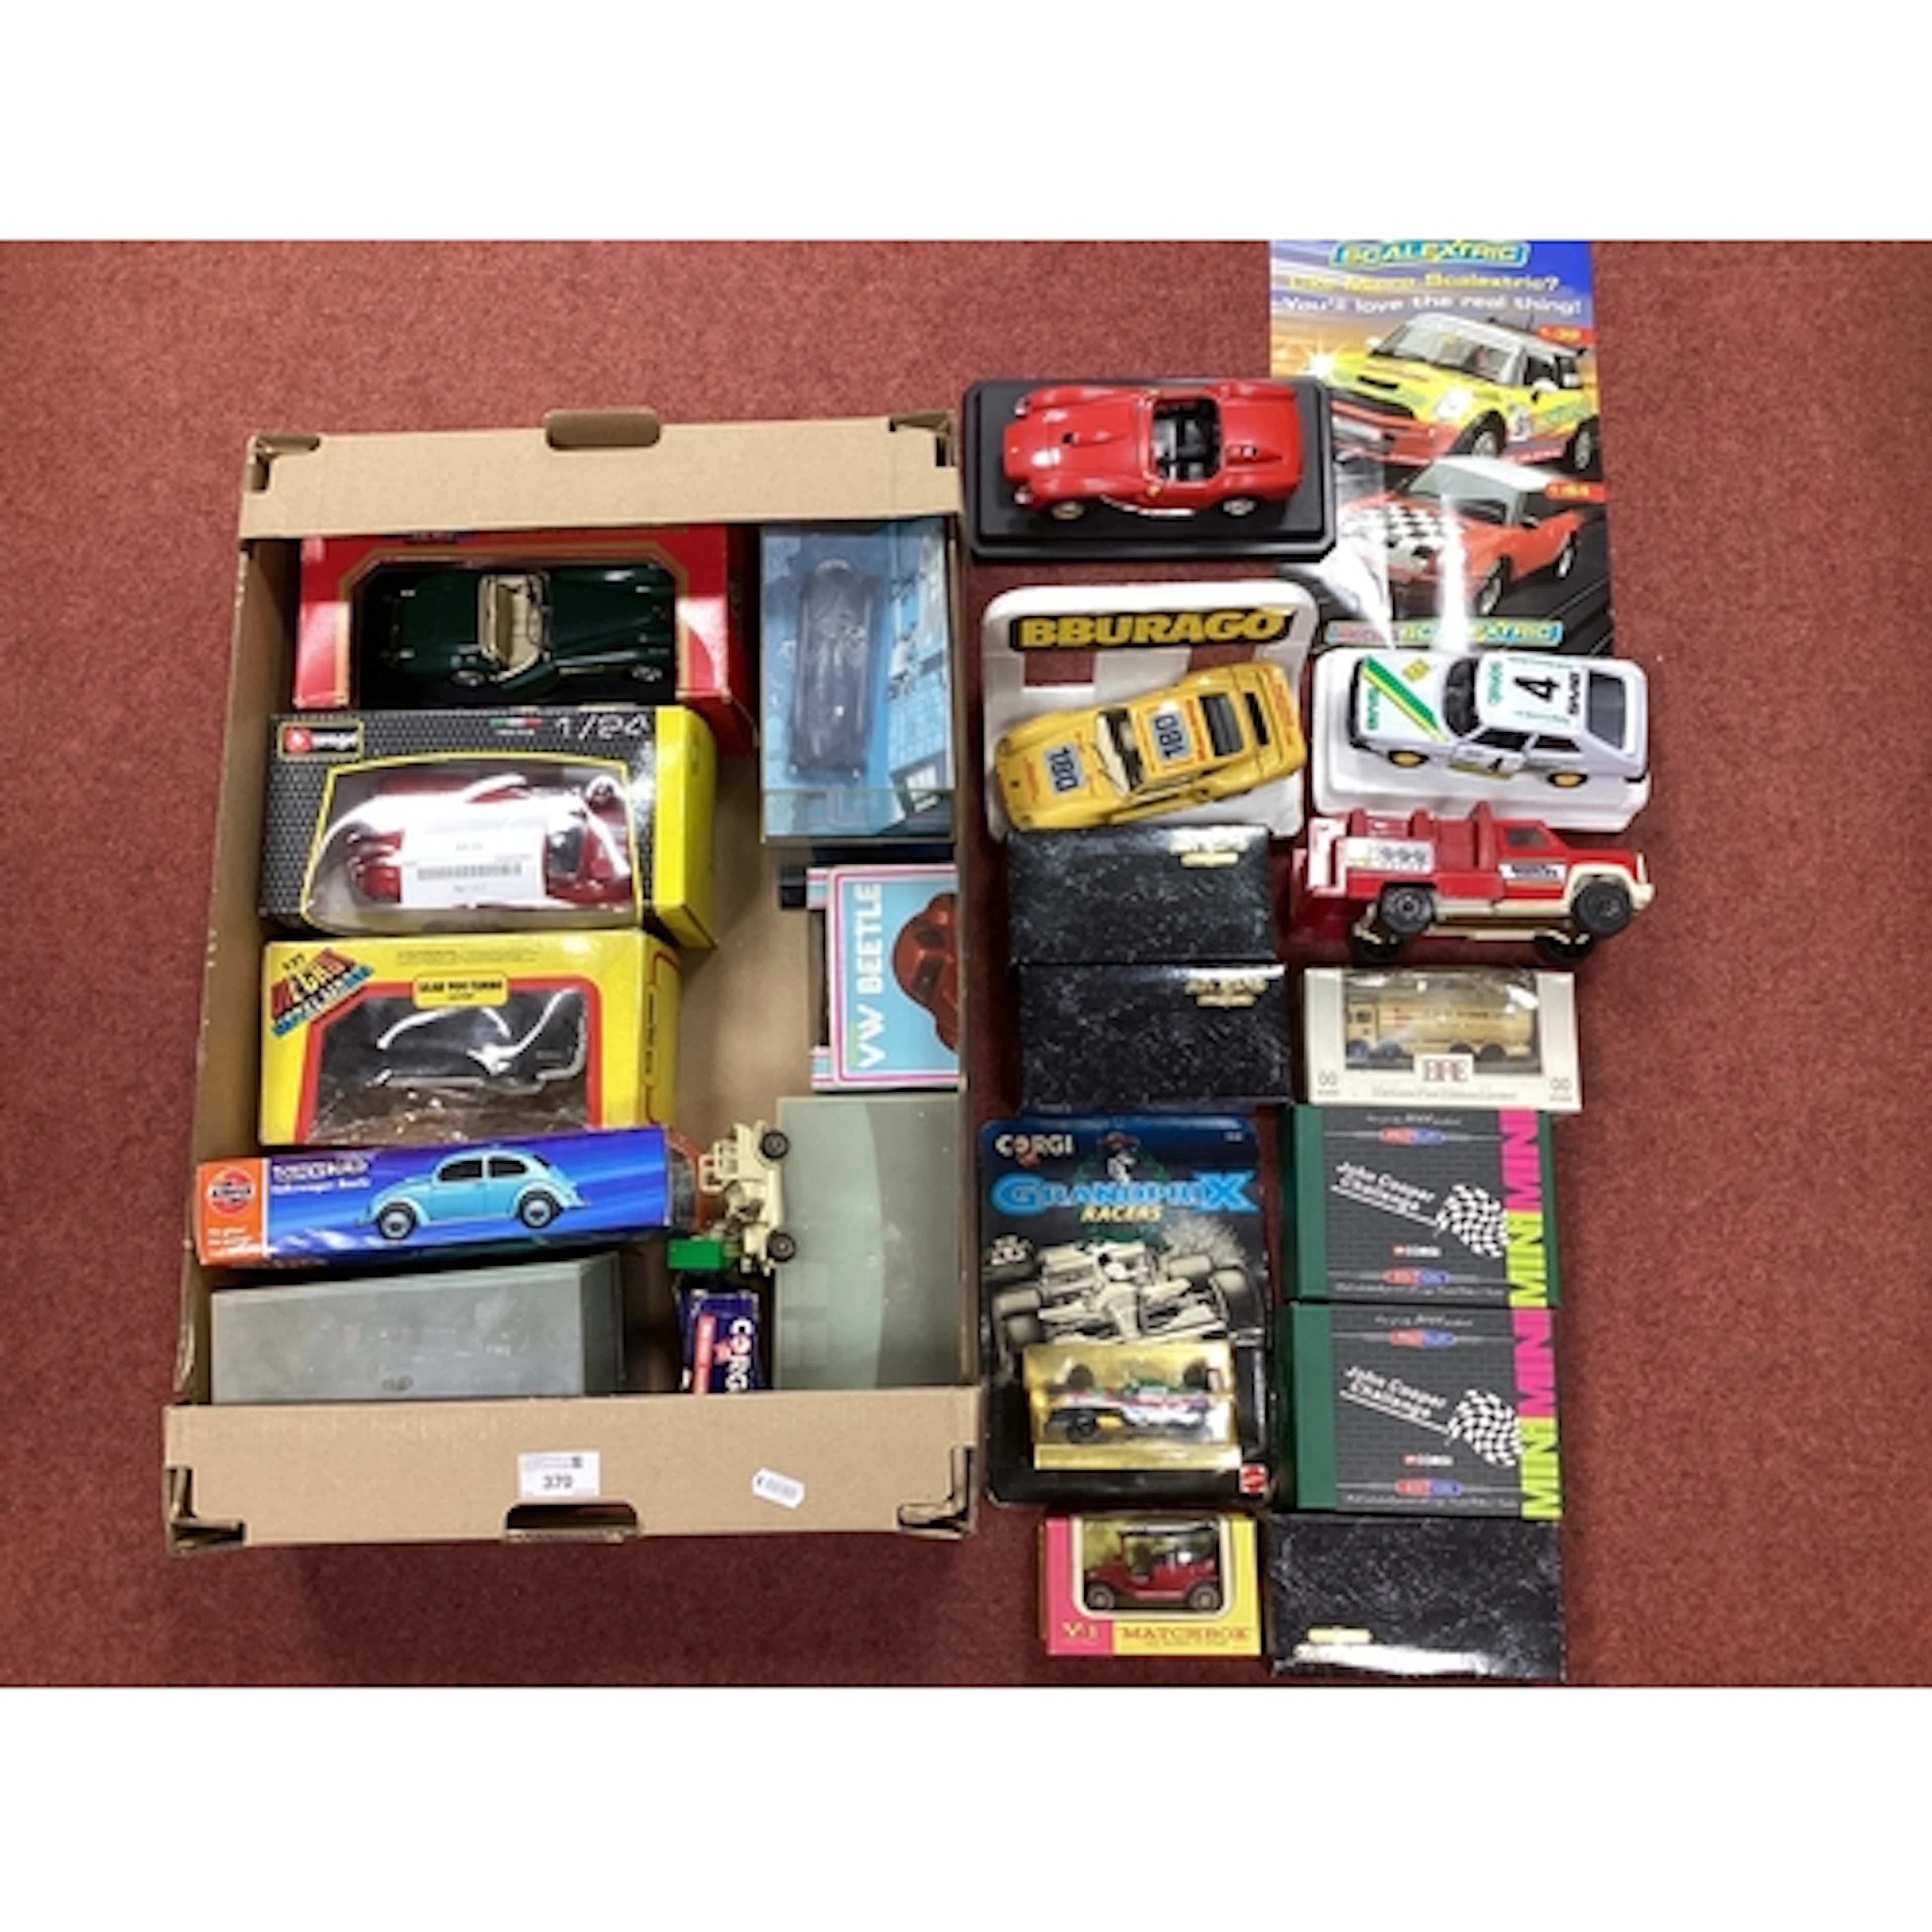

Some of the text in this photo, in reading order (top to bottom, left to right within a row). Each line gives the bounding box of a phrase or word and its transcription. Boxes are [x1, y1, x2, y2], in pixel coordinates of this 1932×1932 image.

[1355, 297, 1404, 313] love
[1413, 295, 1451, 309] the
[1460, 295, 1507, 309] real
[1513, 296, 1582, 314] thing!
[1021, 609, 1286, 647] BBURAGO
[1513, 675, 1561, 703] 4
[1156, 715, 1184, 758] 180
[1048, 746, 1079, 792] 180
[854, 883, 886, 1069] VW BEETLE
[995, 1133, 1074, 1156] CORGI
[1080, 1206, 1163, 1223] RACERS
[725, 1319, 753, 1393] CORG
[1121, 1626, 1251, 1640] MATCHBOX
